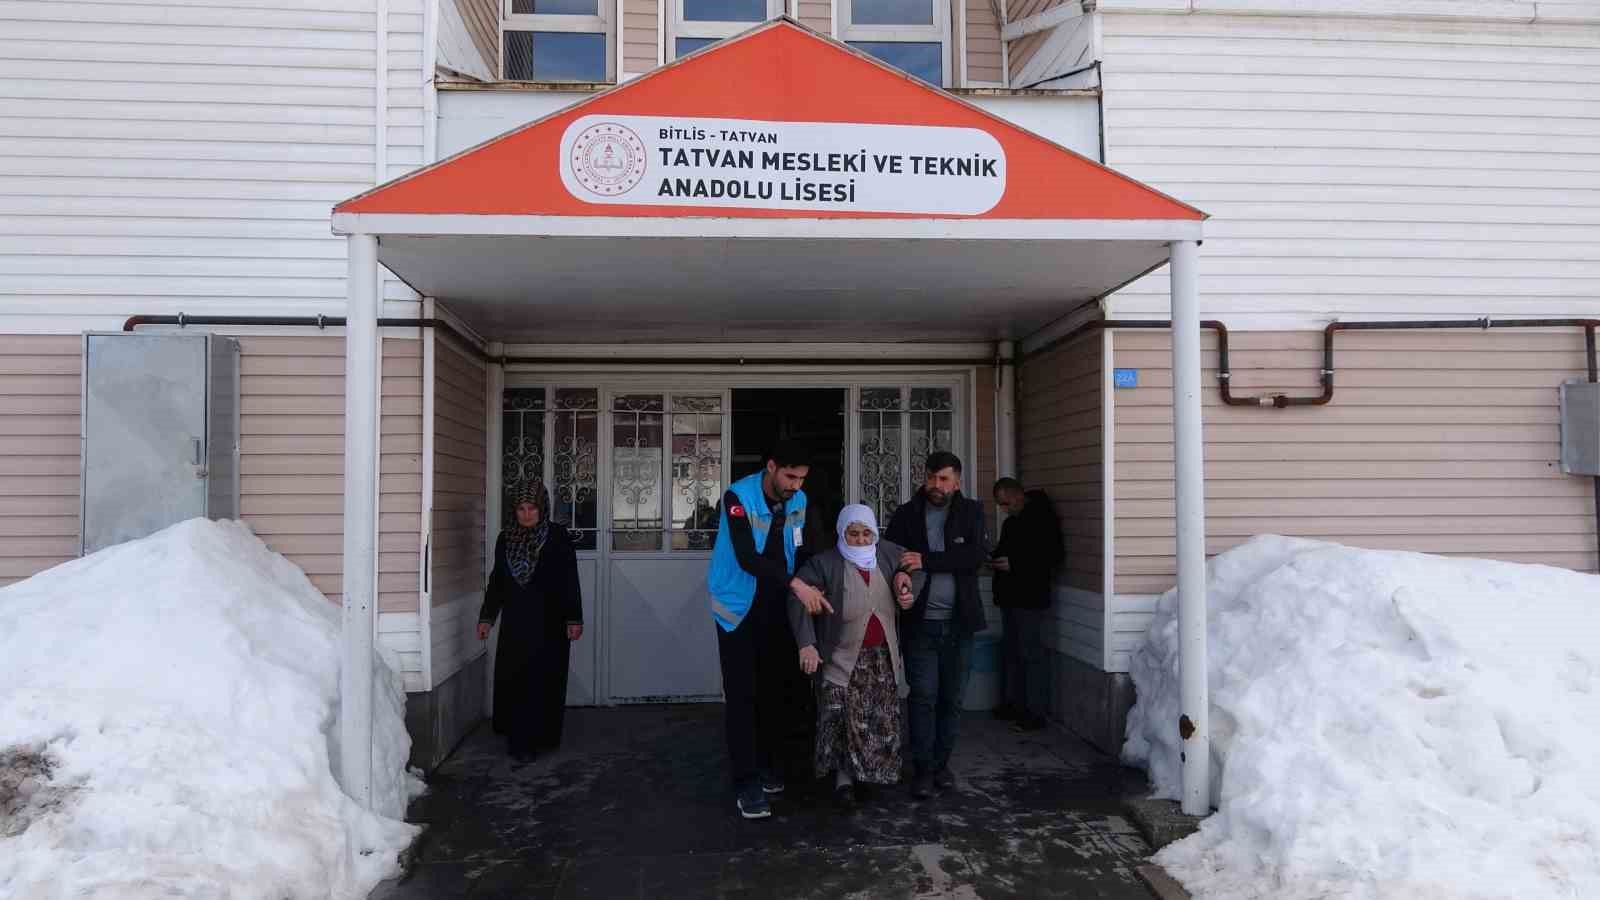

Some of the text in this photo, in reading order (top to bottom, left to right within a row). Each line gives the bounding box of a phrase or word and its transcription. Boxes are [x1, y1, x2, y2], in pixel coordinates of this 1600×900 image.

[659, 126, 706, 141] BİTLİS
[719, 130, 777, 144] TATVAN
[658, 147, 754, 169] TATVAN
[761, 149, 866, 173] MESLEKİ
[872, 154, 903, 174] VE
[909, 153, 997, 178] TEKNİK
[657, 177, 855, 203] ANADOLU LİSESİ
